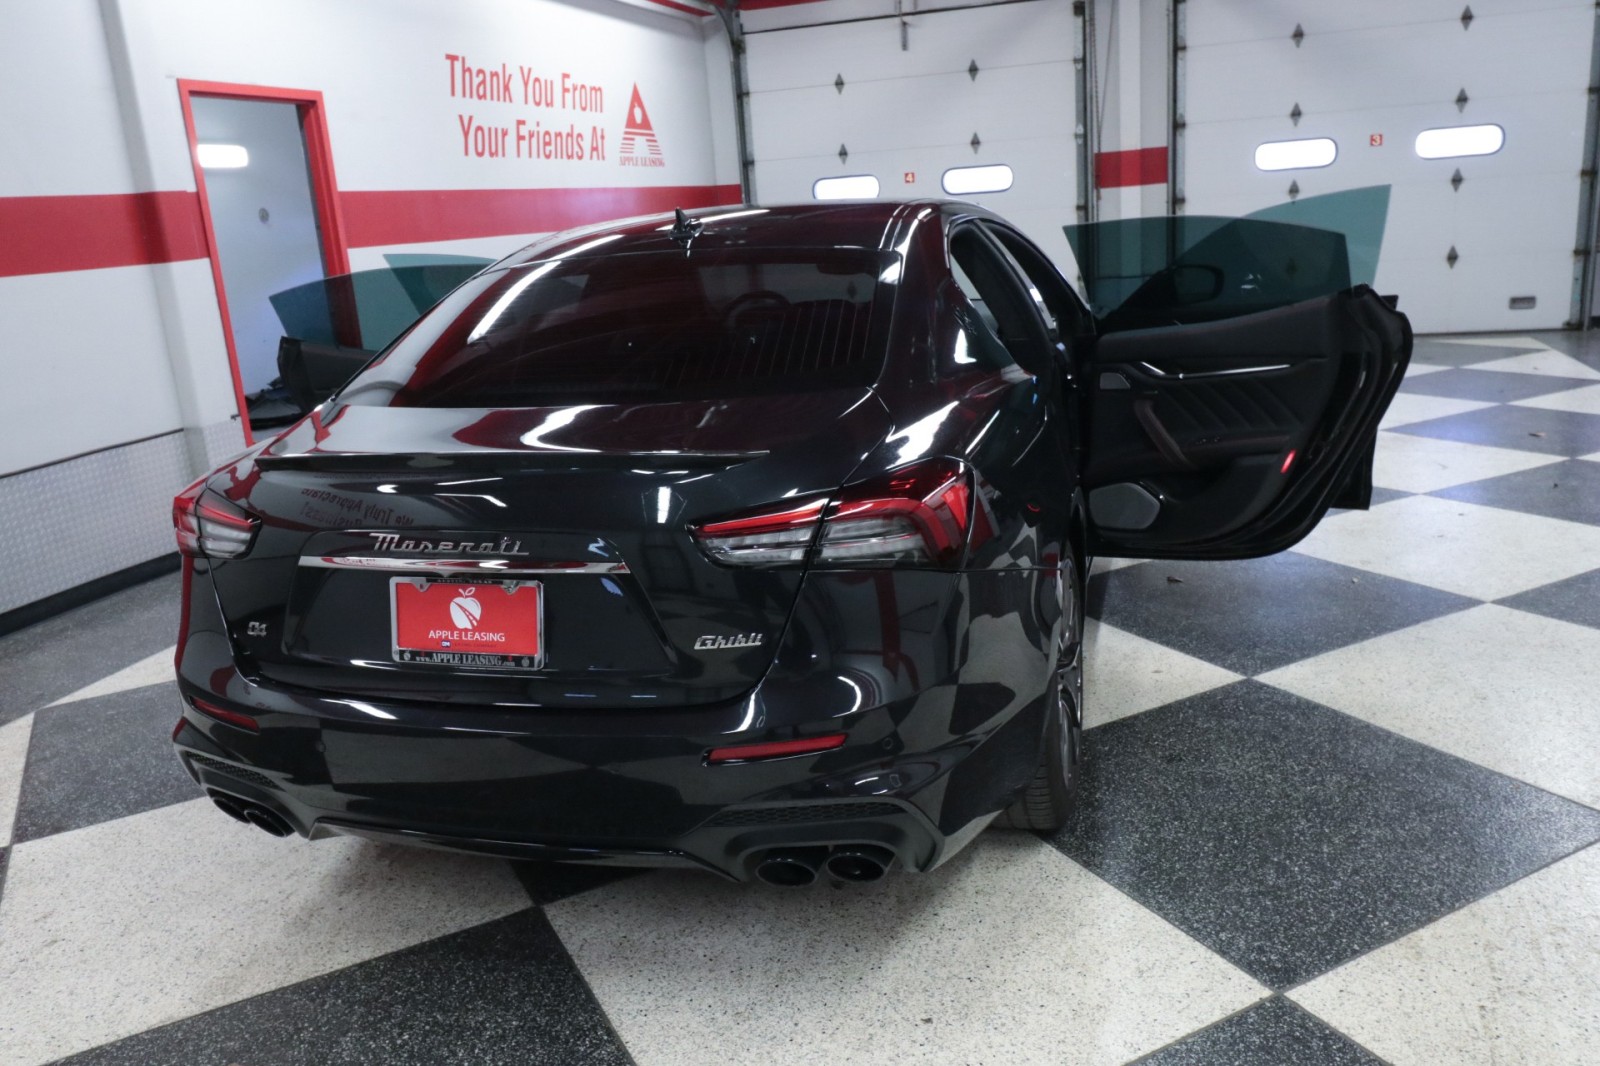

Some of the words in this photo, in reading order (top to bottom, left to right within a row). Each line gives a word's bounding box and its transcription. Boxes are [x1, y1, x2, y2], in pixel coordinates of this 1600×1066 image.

[445, 53, 513, 103] Thank
[519, 65, 554, 108] You
[561, 72, 604, 113] From
[458, 114, 508, 158] Your
[516, 119, 584, 161] Friends
[589, 125, 606, 161] At
[1371, 135, 1381, 145] 3
[906, 173, 914, 183] 4
[369, 532, 529, 556] Maserati
[428, 630, 460, 640] APPLE
[462, 631, 505, 642] LEASING
[694, 632, 762, 650] Ghibli
